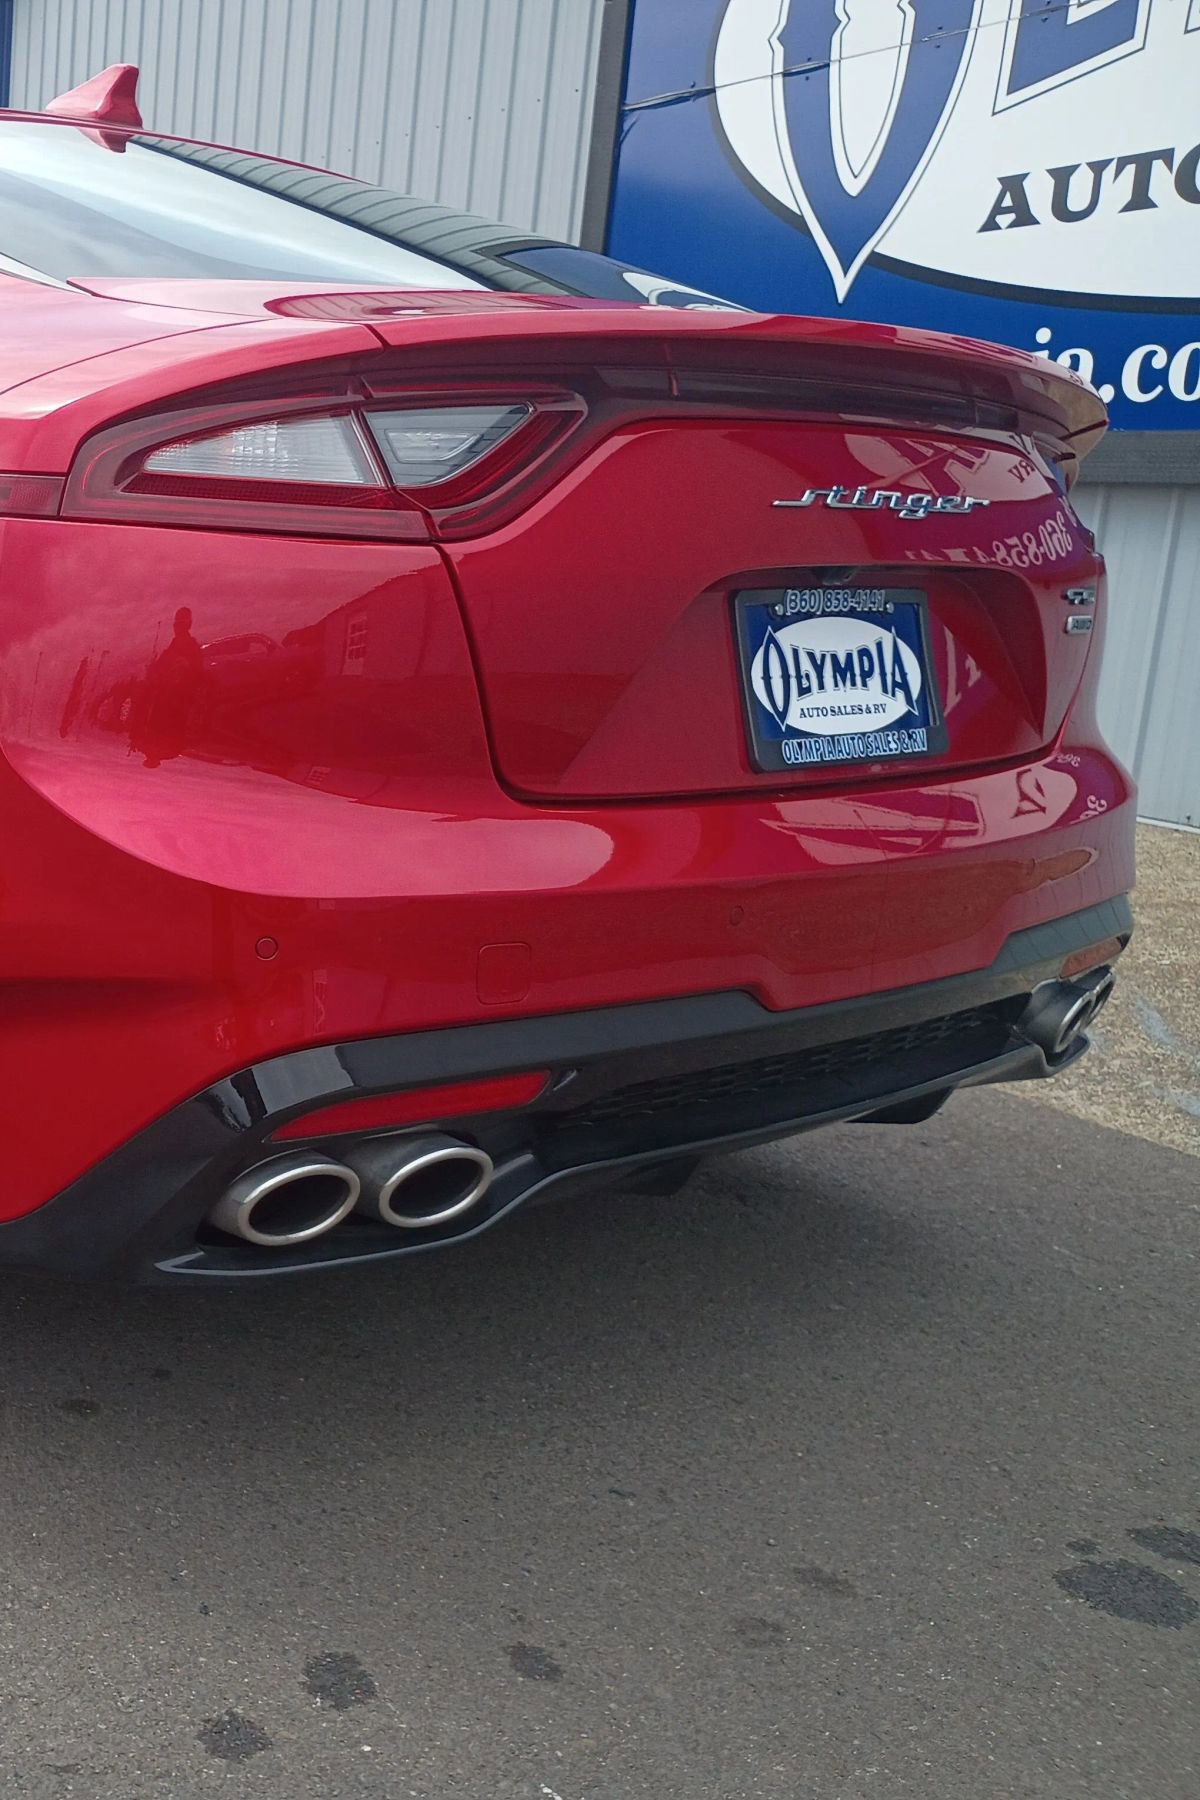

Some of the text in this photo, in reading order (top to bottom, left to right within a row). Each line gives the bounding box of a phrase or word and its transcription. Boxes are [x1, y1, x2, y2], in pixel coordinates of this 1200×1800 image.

[761, 625, 919, 733] OLYMPIA
[799, 703, 888, 719] AUTO SALES & RV
[782, 728, 928, 764] OLYMPIA AUTO SALES & RV
